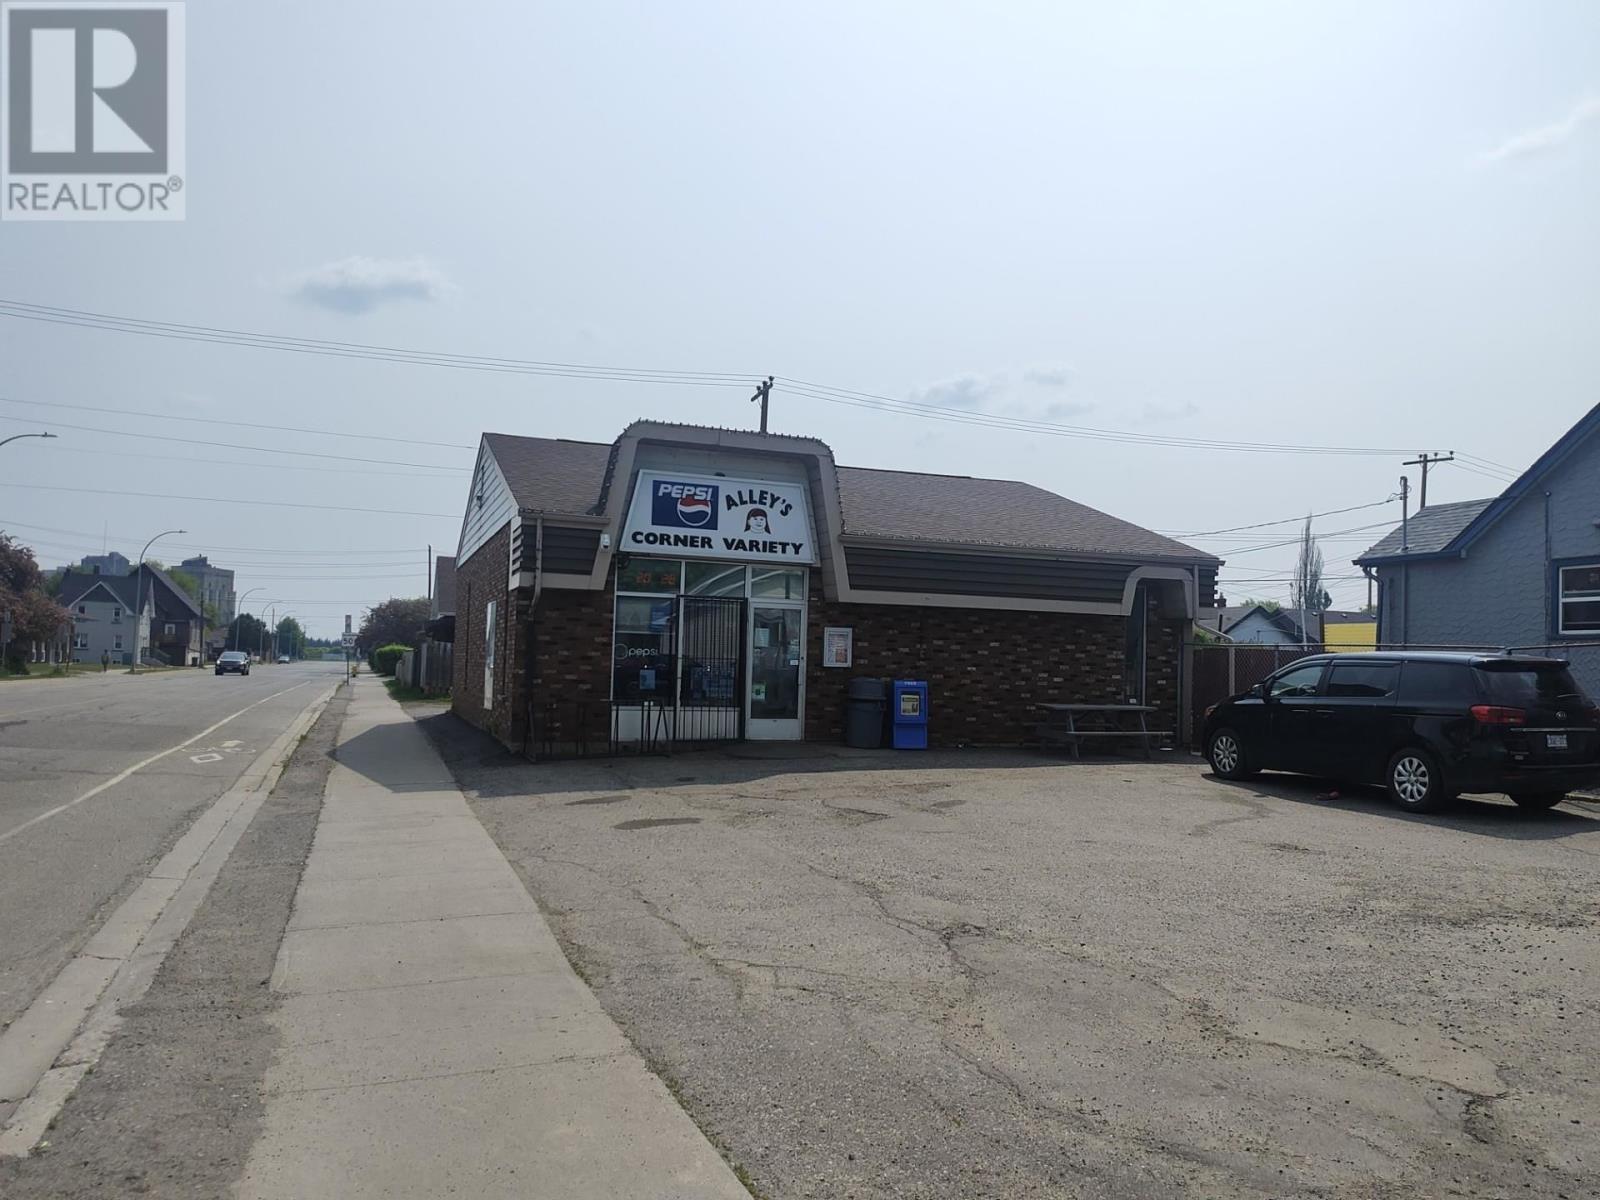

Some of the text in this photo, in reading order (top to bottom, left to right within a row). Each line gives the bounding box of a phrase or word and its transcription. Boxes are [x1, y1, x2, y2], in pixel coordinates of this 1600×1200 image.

[658, 484, 713, 501] PEPSI
[725, 489, 793, 517] ALLEY'S
[631, 531, 803, 555] CORNER VARIETY
[343, 637, 353, 645] 50
